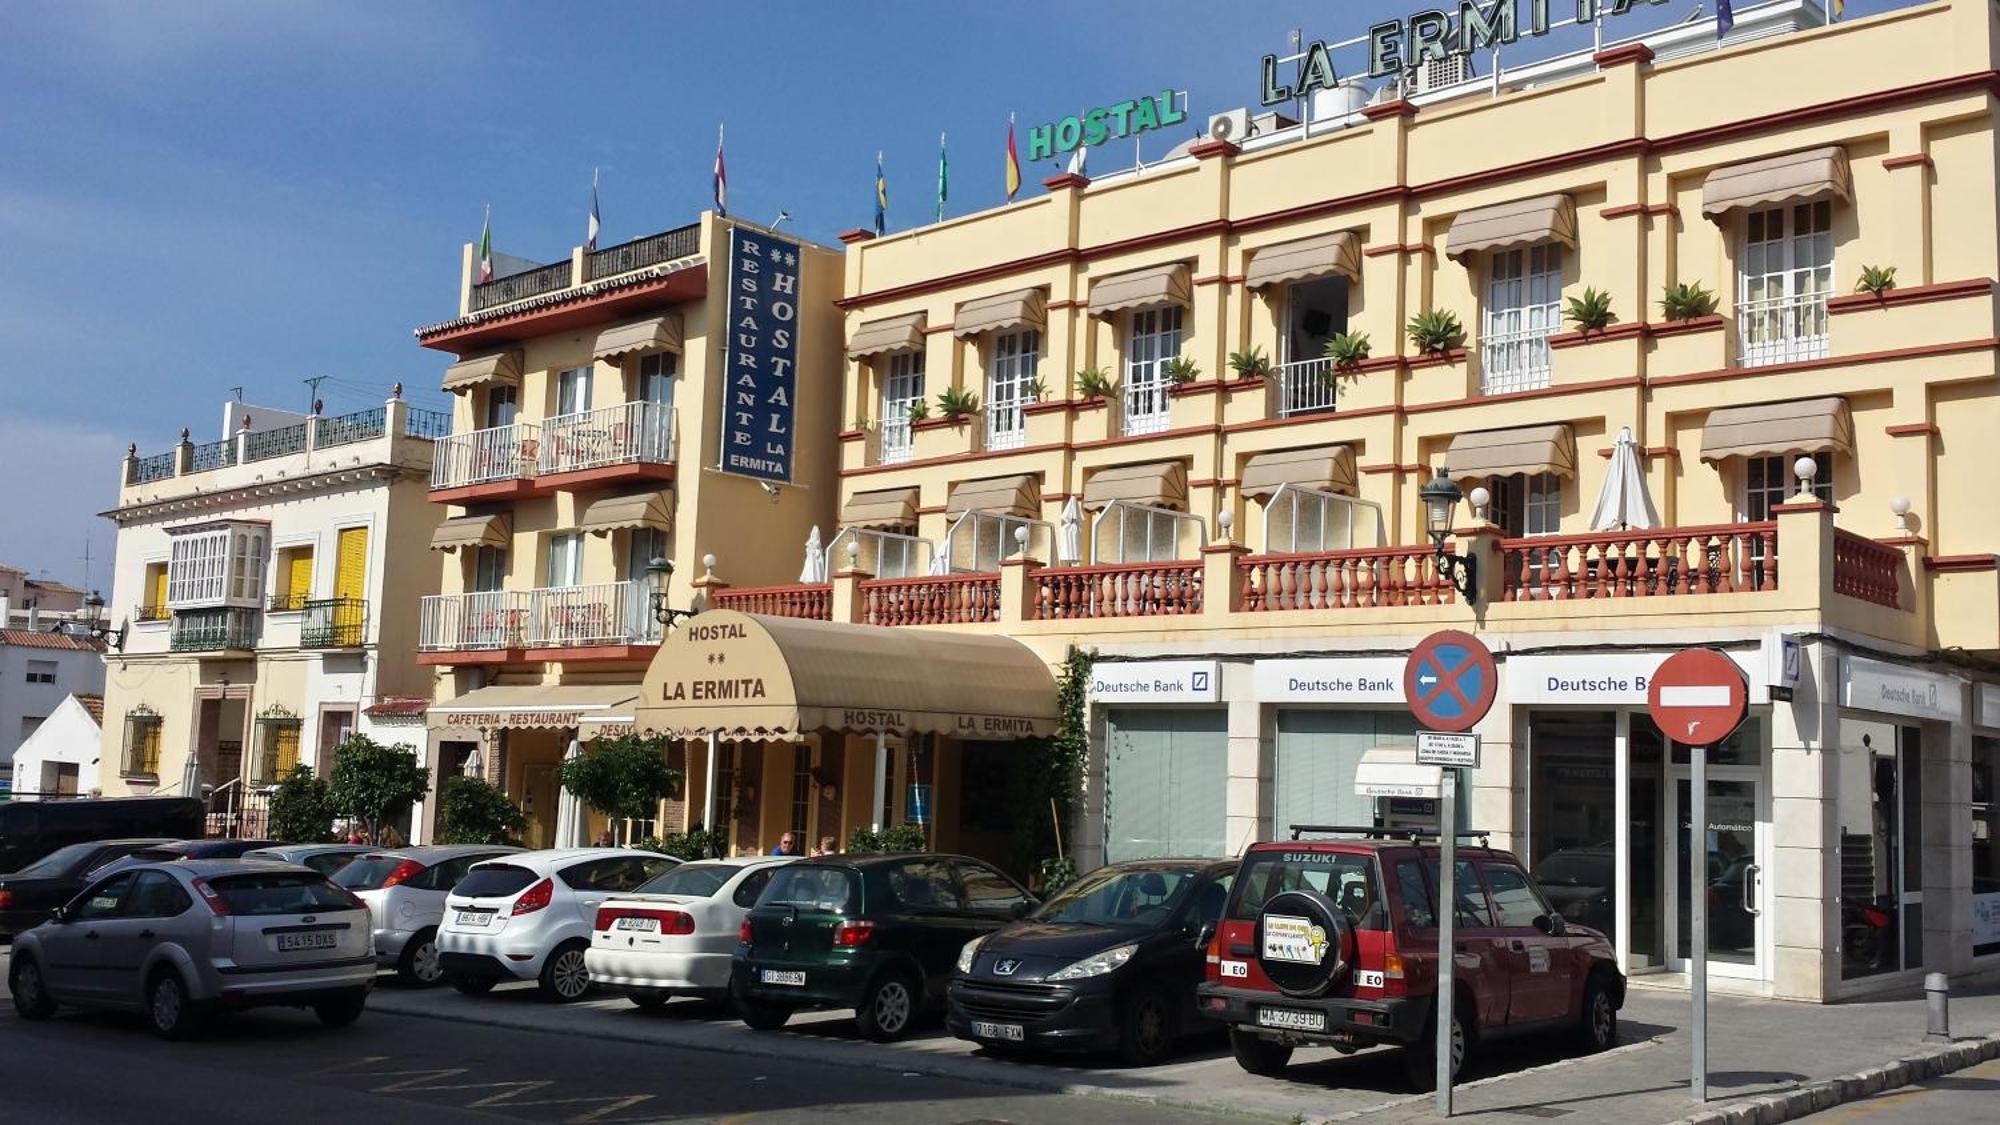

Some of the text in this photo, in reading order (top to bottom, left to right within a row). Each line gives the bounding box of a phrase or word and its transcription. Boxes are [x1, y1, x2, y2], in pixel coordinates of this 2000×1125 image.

[1262, 0, 1669, 106] LA ERMI
[1028, 89, 1186, 161] HOSTAL
[734, 240, 761, 446] RESTAURANTE
[767, 273, 795, 434] HOSTAL
[766, 442, 785, 456] LA
[730, 454, 784, 474] ERMITA
[688, 623, 747, 641] HOSTAL
[663, 678, 766, 701] LA ERMITA
[1096, 679, 1184, 693] Deutsche Bank
[1287, 678, 1395, 692] Deutsche Bank
[1547, 676, 1628, 692] Deutsche
[447, 714, 500, 725] CAFETERIA
[844, 710, 1035, 733] HOSTAL LA ERMITA
[1283, 853, 1336, 863] SUZUKI
